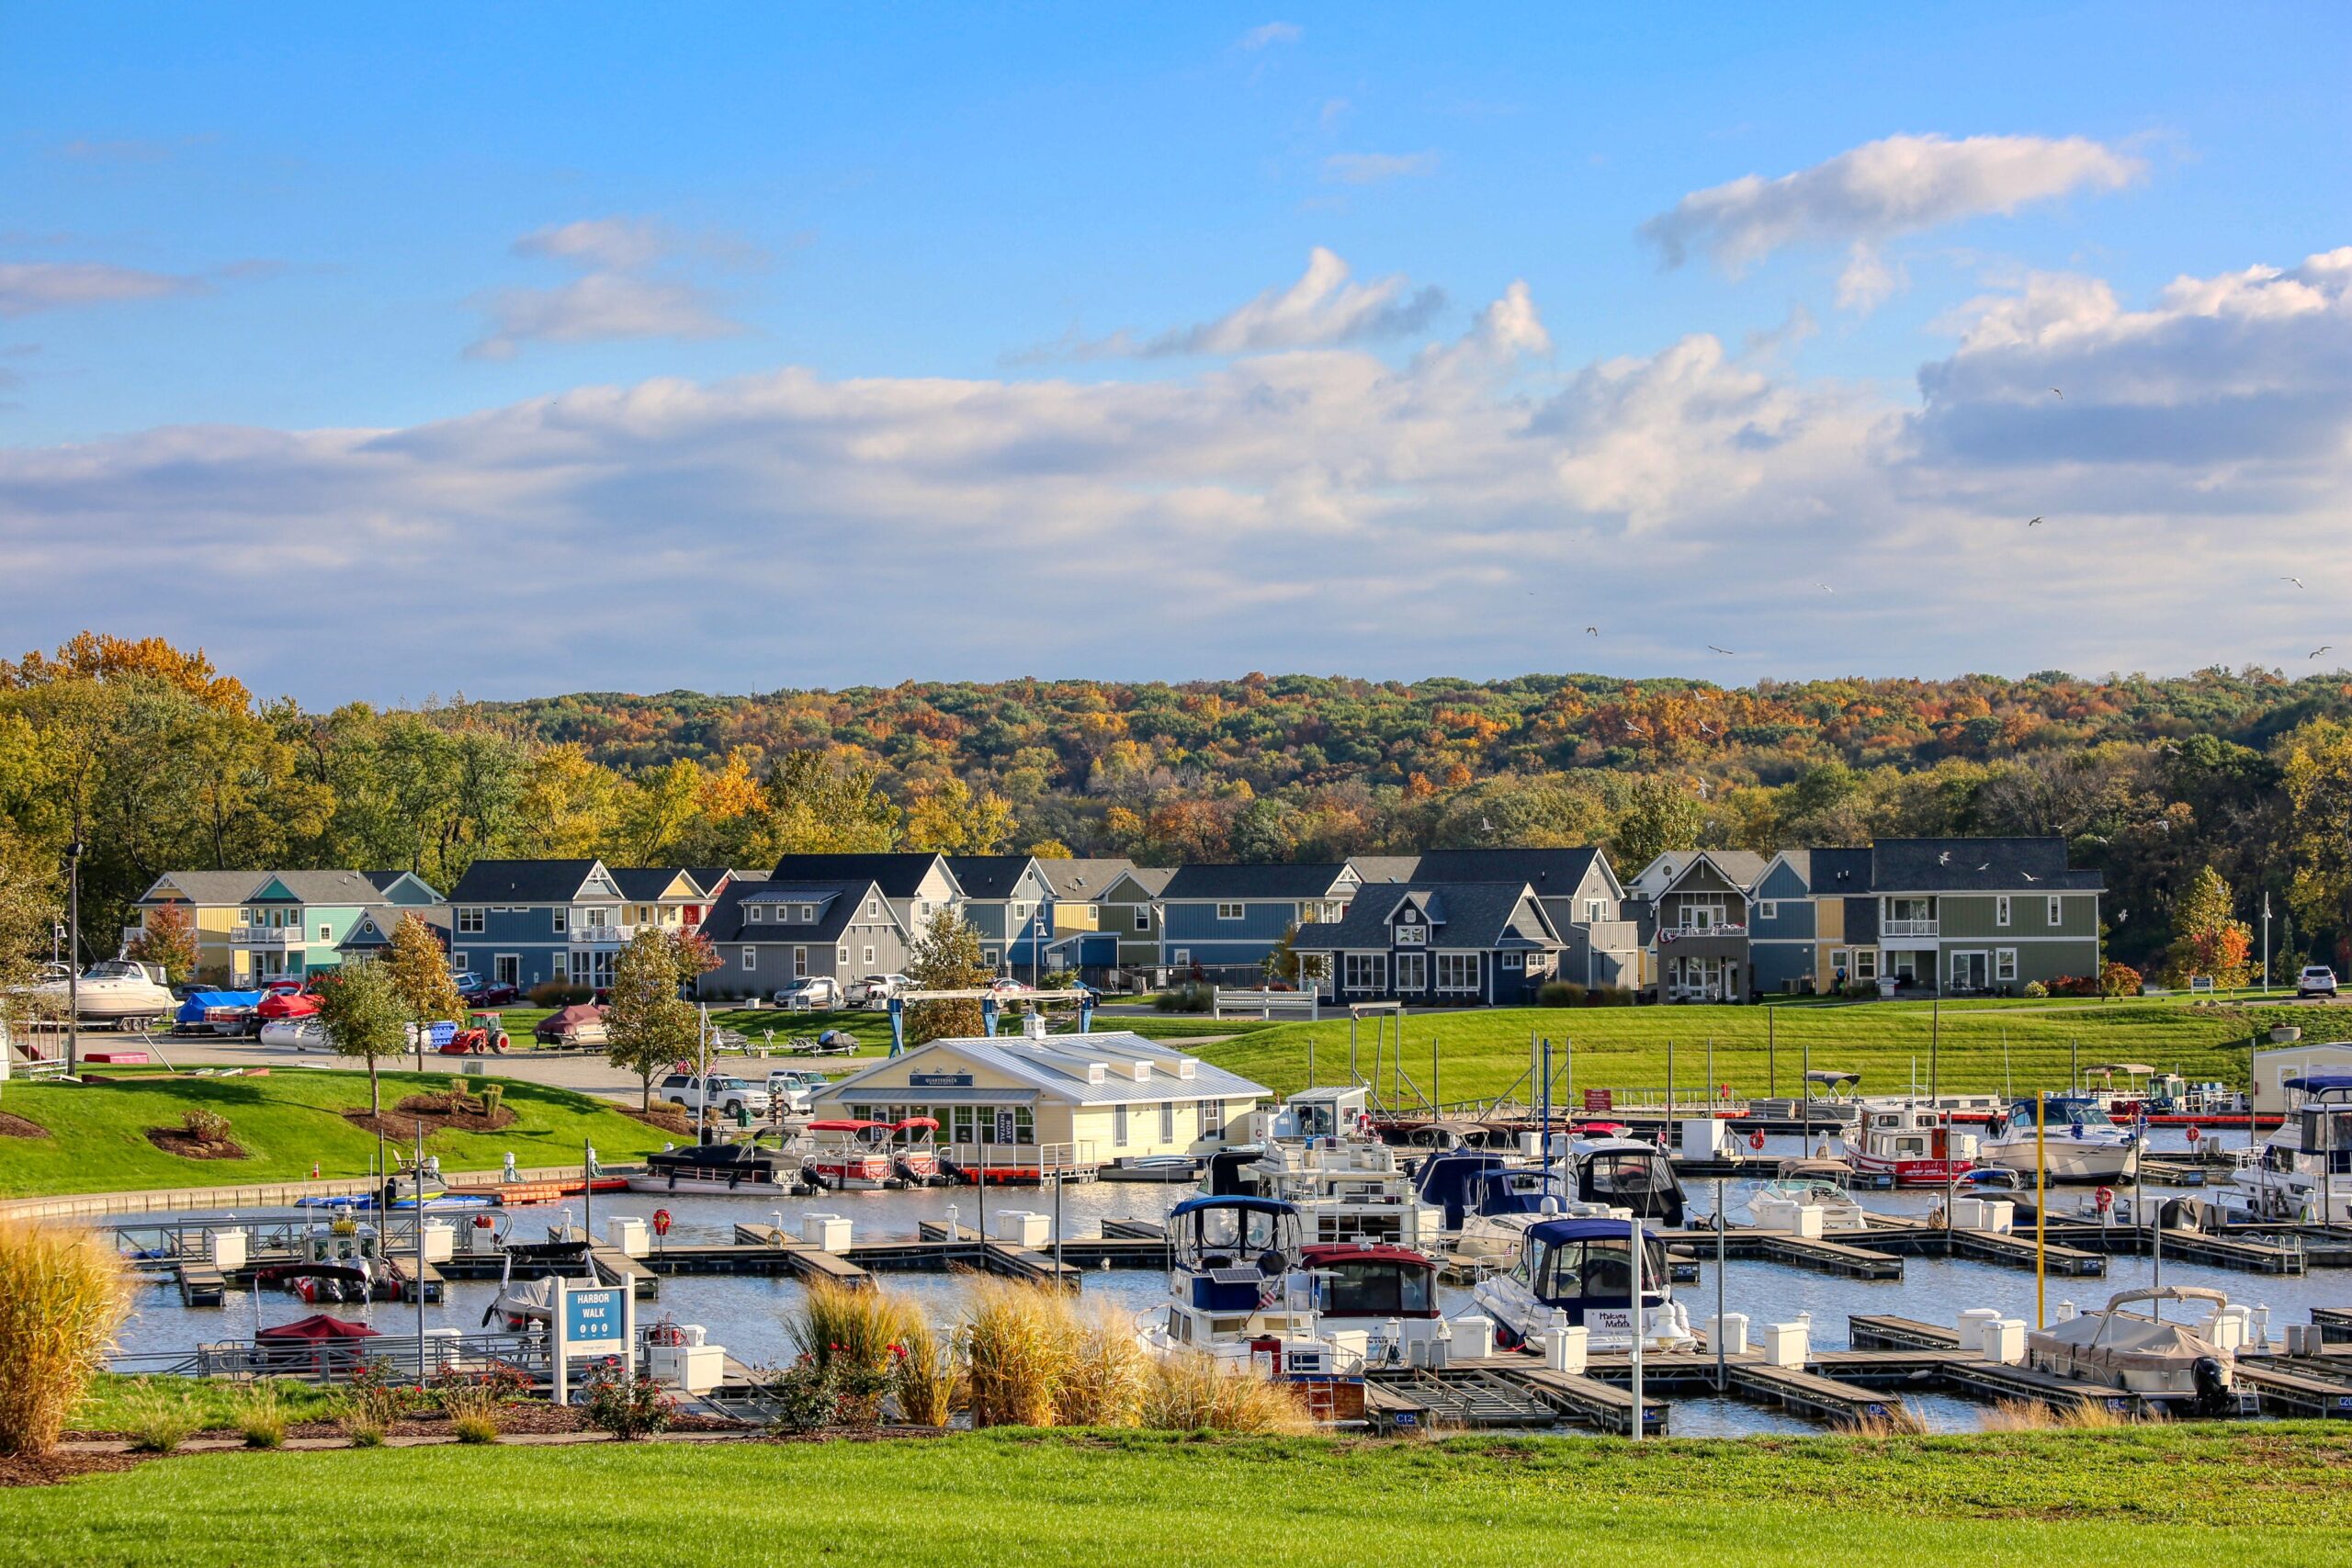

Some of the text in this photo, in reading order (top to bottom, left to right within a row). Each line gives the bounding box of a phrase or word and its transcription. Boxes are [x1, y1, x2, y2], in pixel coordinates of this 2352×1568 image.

[577, 1293, 610, 1304] HARBOR
[582, 1307, 605, 1318] WALK
[1599, 1312, 1627, 1321] Hakuna
[1605, 1319, 1630, 1328] Matata
[2107, 1398, 2120, 1408] C18
[1869, 1404, 1882, 1414] C16
[1396, 1414, 1414, 1423] C12
